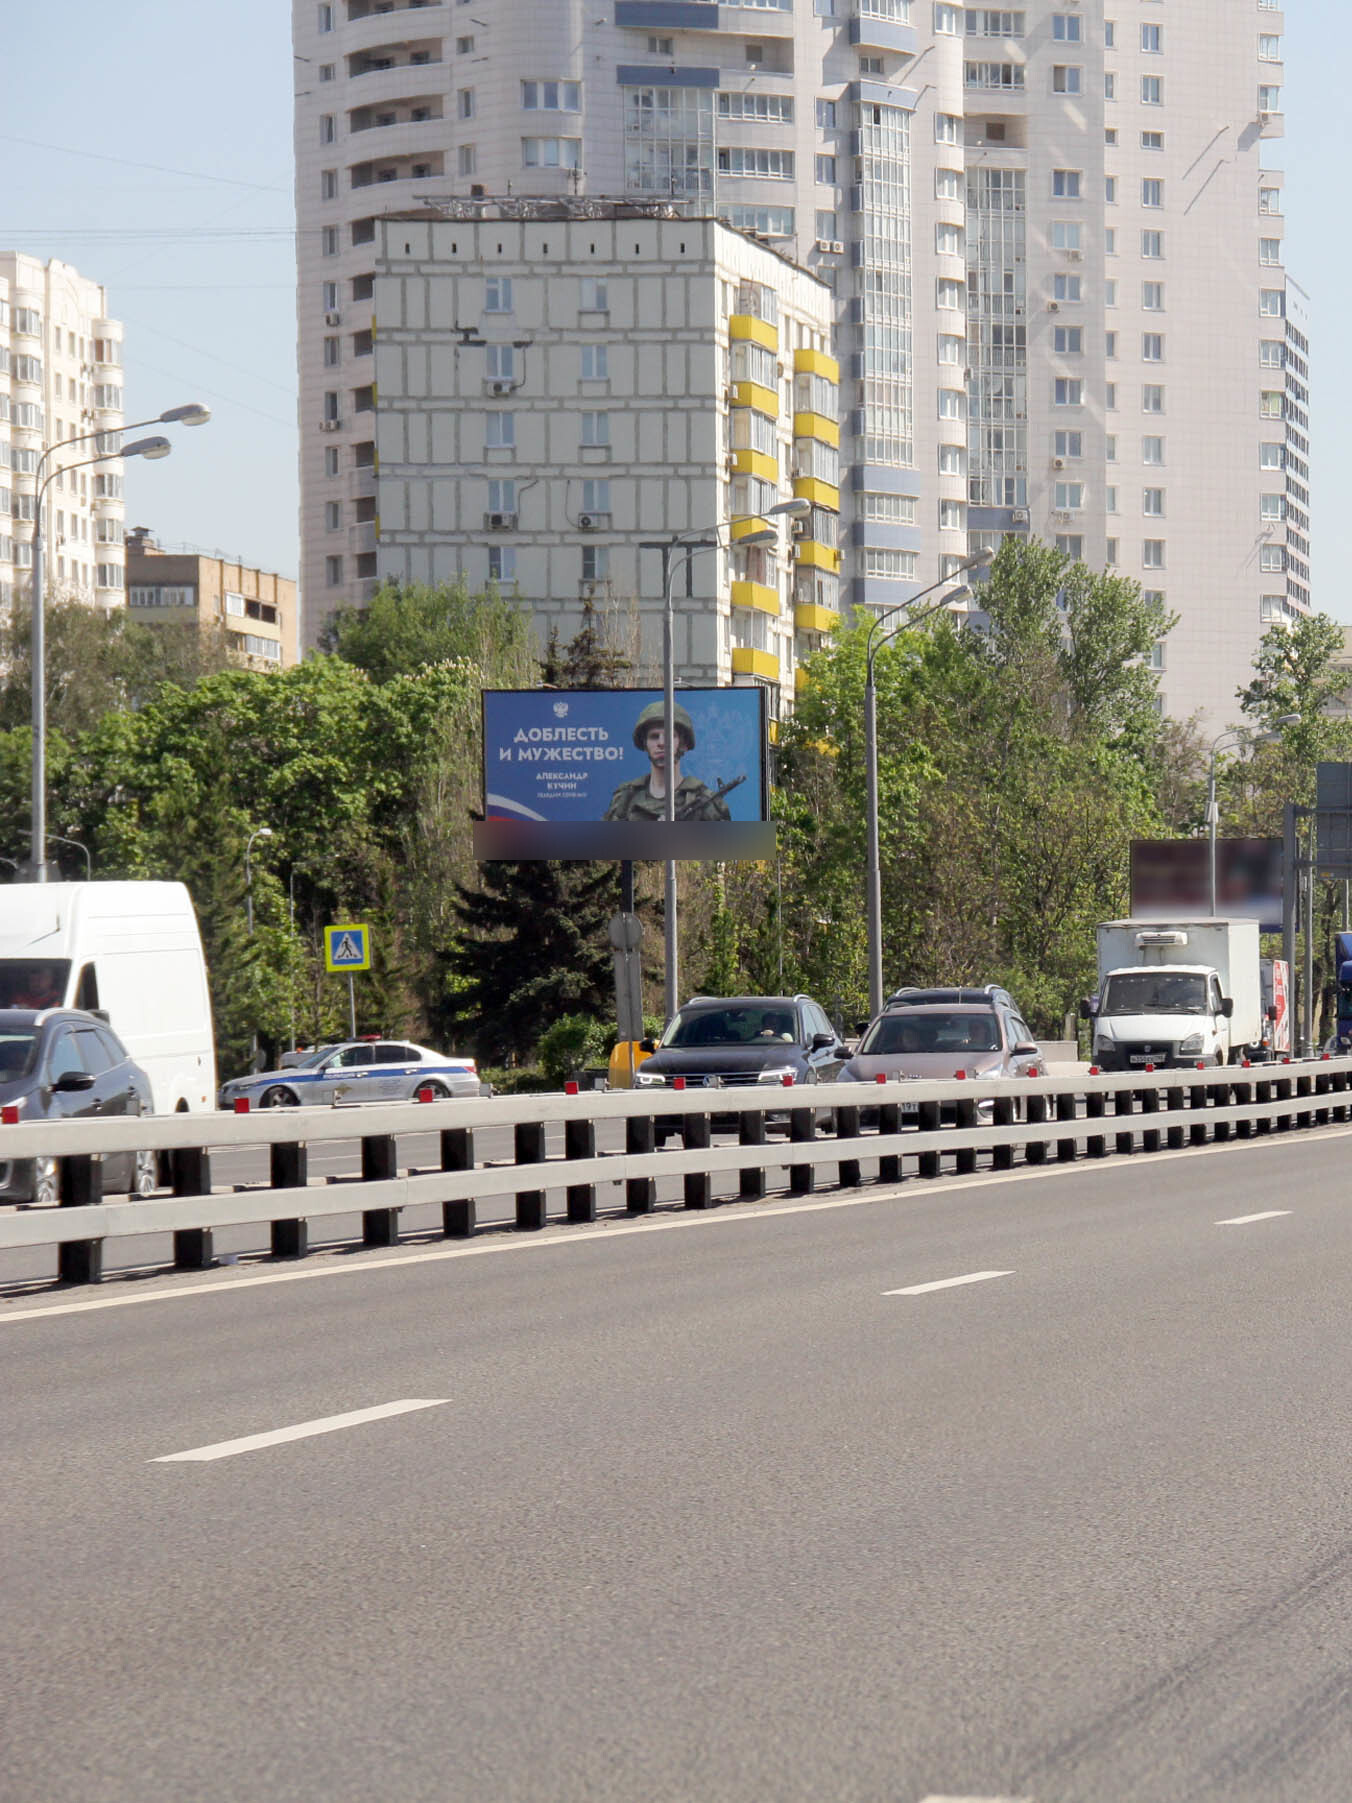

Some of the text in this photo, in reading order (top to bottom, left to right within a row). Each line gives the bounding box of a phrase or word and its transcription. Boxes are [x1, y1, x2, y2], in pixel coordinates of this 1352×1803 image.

[513, 728, 609, 743] ДОБЛЕСТЬ
[499, 746, 625, 761] И МУЖЕСТВО!
[535, 772, 589, 781] АЛЕКСАНДР
[547, 782, 577, 790] КУЧИН
